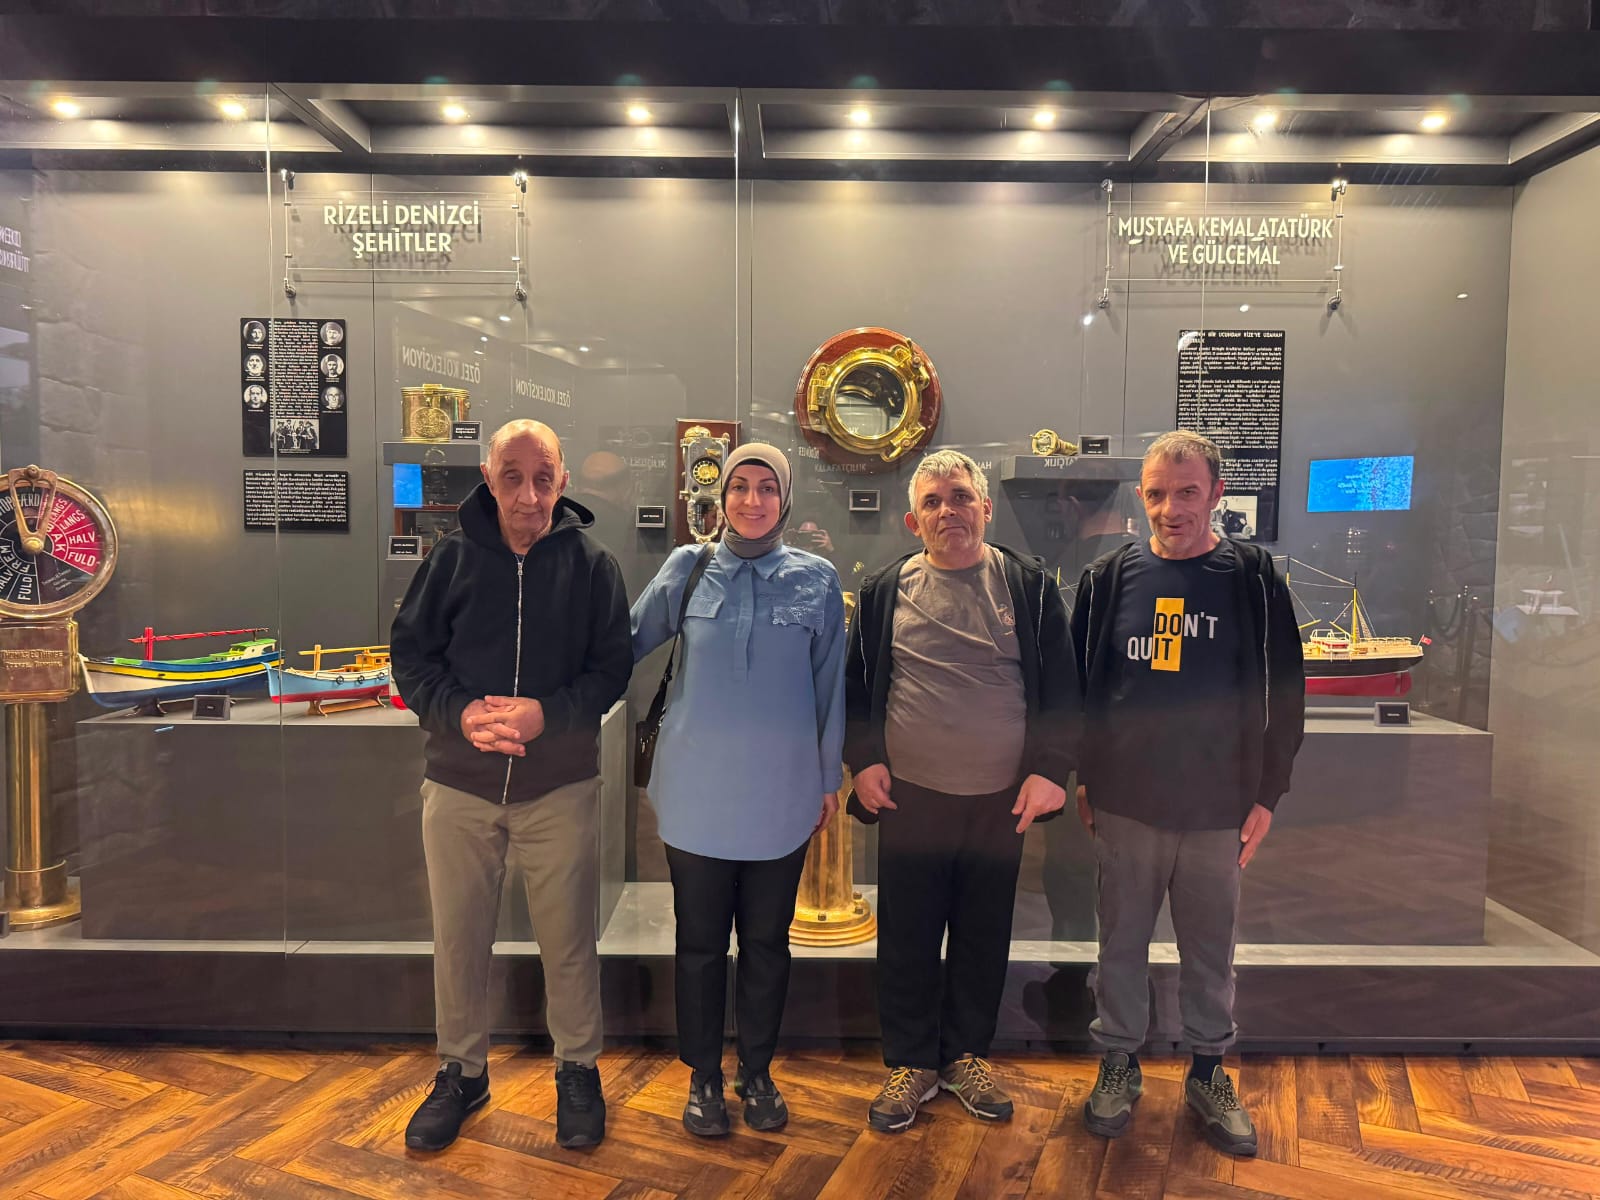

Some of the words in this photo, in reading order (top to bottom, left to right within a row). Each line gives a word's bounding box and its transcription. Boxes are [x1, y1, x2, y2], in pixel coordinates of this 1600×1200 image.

[323, 200, 389, 225] RİZELİ
[395, 200, 480, 225] DENİZCİ
[1118, 216, 1195, 237] MUSTAFA
[1198, 217, 1255, 238] KEMAL
[1257, 213, 1334, 239] ATATÜRK
[352, 227, 452, 258] ŞEHİTLER
[1168, 245, 1189, 264] VE
[1192, 239, 1281, 265] GÜLCEMAL
[68, 530, 96, 545] HALV
[68, 551, 96, 567] FULD
[17, 576, 33, 601] FULD
[1154, 611, 1218, 639] DON'T
[1127, 636, 1173, 661] QUIT
